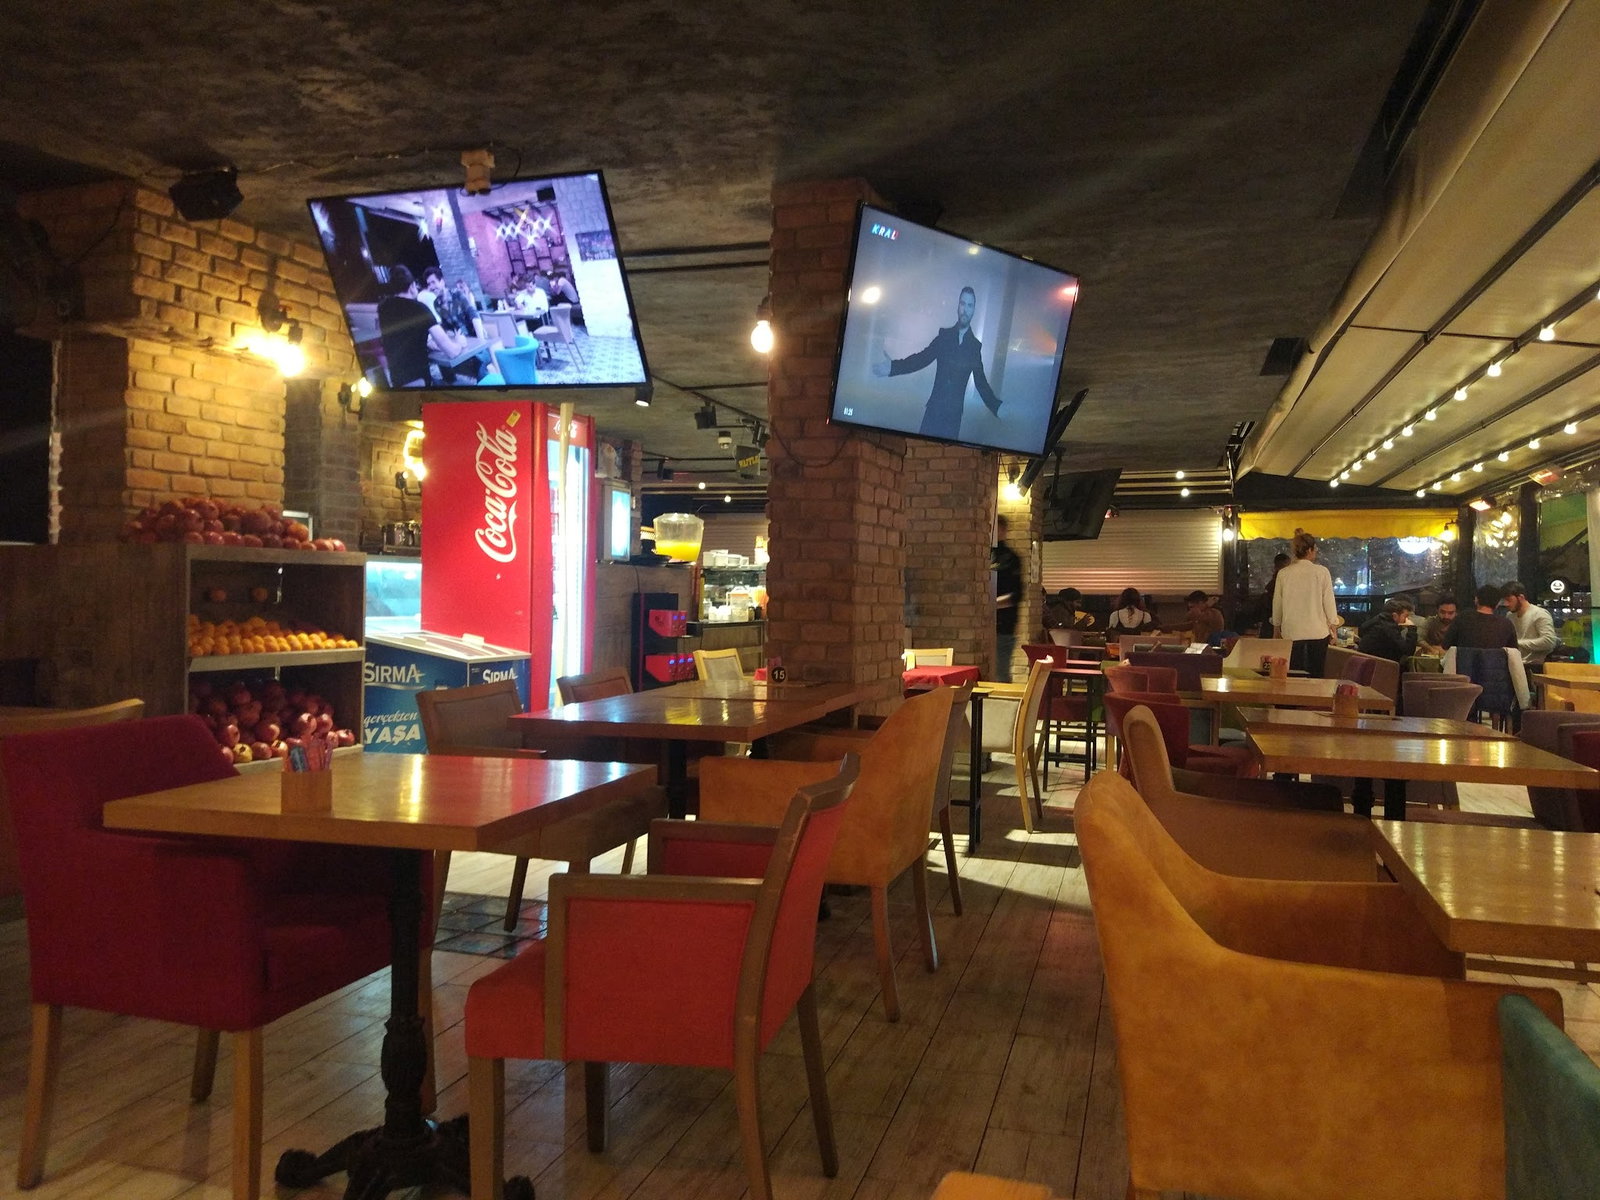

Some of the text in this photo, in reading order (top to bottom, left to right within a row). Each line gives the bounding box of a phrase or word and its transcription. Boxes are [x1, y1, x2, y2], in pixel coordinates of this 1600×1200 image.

[871, 223, 899, 240] KRAL
[474, 420, 518, 563] Coca-Cola
[364, 661, 425, 684] SIRMA
[773, 670, 785, 680] 15
[364, 723, 421, 746] YAŞA
